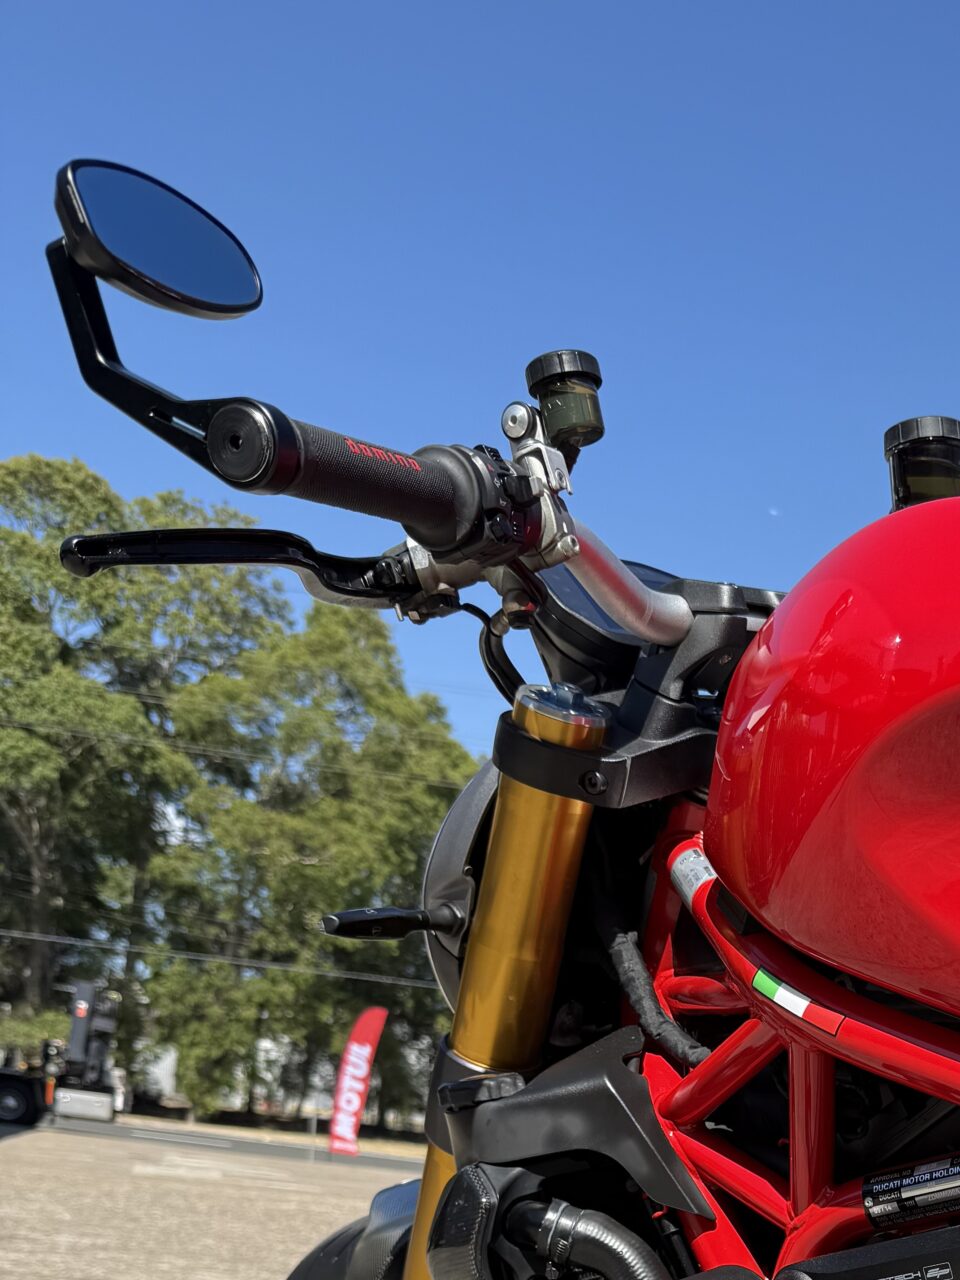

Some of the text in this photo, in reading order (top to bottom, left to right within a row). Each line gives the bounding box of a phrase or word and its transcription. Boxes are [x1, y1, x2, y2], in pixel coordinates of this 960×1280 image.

[343, 436, 422, 473] domino
[332, 1041, 373, 1140] MOTUL
[873, 1181, 900, 1193] DUCATI
[902, 1173, 930, 1186] MOTOR
[879, 1191, 900, 1202] DUCATI
